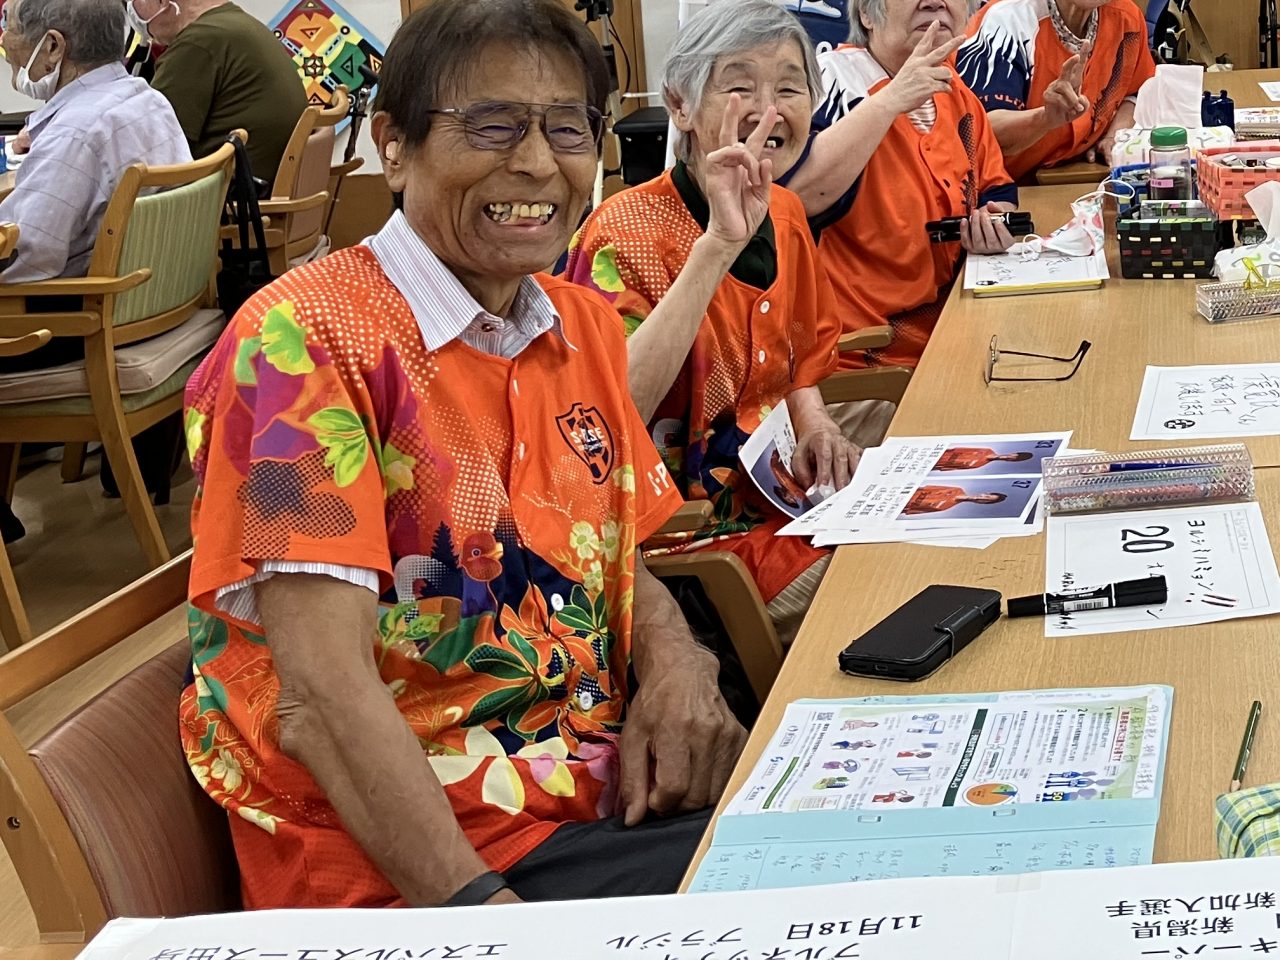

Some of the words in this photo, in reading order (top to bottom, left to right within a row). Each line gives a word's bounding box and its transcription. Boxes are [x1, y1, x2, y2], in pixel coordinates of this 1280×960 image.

[1120, 525, 1175, 554] 20
[1105, 891, 1276, 918] 新加入選手
[606, 928, 742, 950] ブラジル
[787, 915, 923, 940] 11月18日
[1131, 916, 1234, 939] 新潟県
